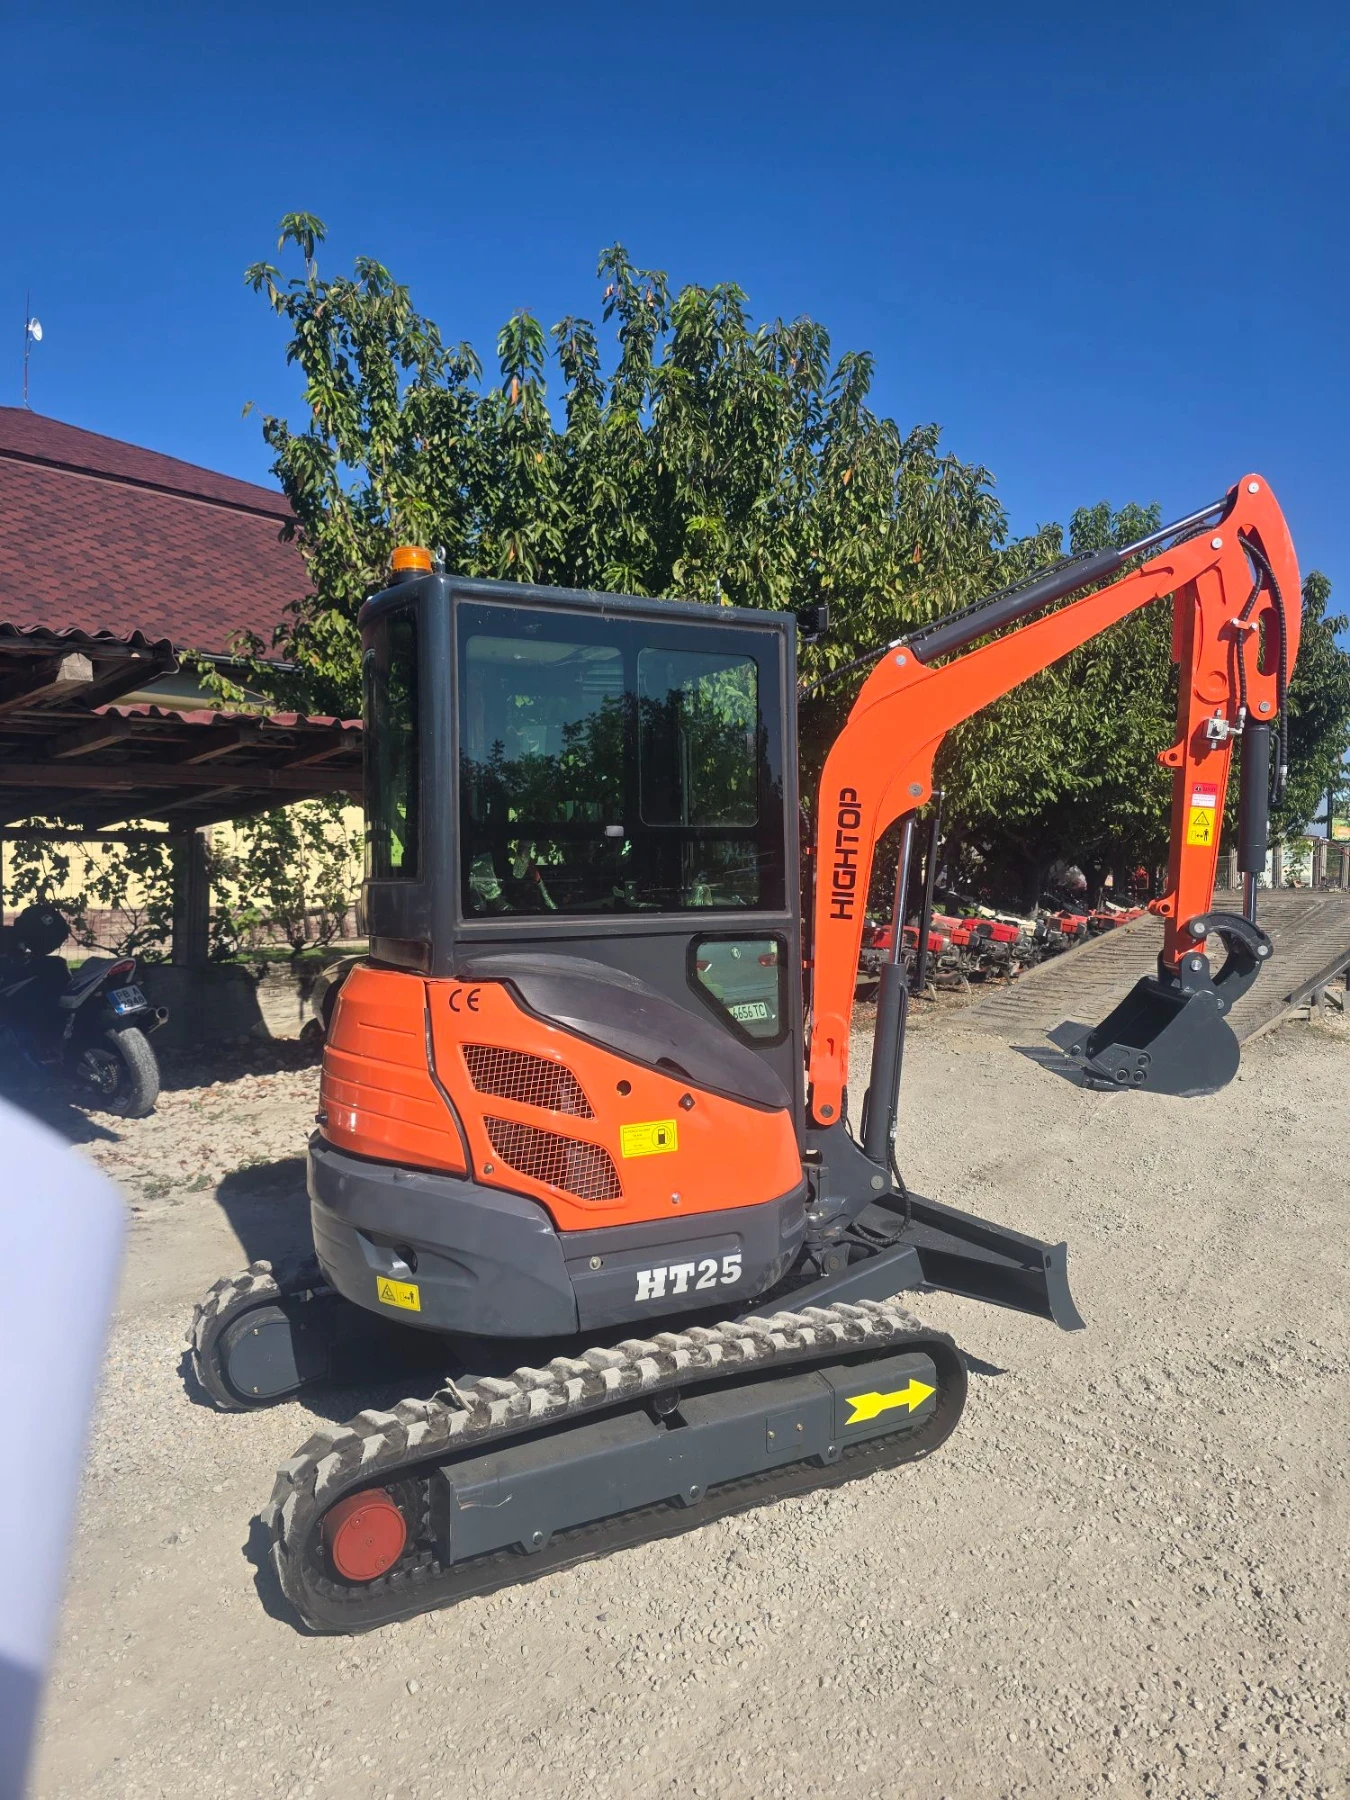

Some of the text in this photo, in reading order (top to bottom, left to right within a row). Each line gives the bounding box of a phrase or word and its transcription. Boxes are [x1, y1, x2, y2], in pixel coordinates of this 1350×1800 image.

[830, 787, 862, 920] HIGHTOP
[449, 988, 481, 1012] CE
[753, 1004, 766, 1017] TC
[634, 1253, 742, 1302] HT25
